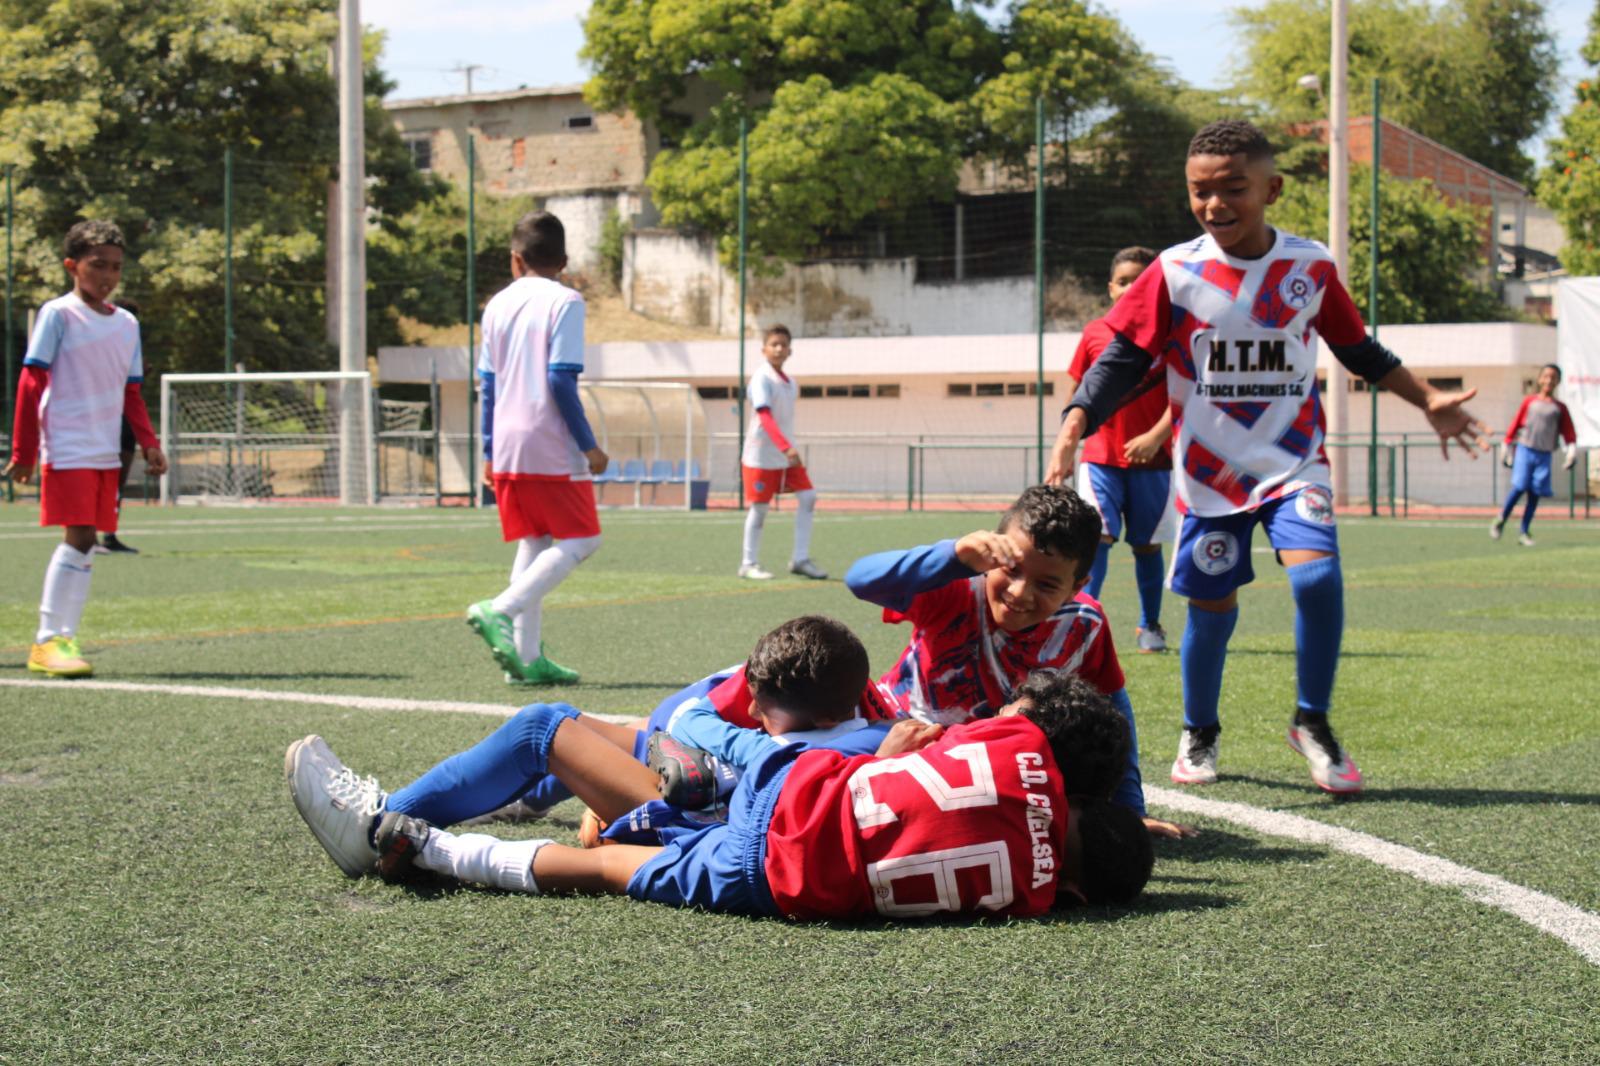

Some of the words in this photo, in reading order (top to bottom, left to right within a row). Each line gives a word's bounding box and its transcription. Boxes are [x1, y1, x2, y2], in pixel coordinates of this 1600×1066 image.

[1208, 340, 1293, 372] H.T.M.
[1015, 751, 1048, 789] C.D.
[847, 742, 1014, 917] 26
[1026, 793, 1055, 888] CHELSEA
